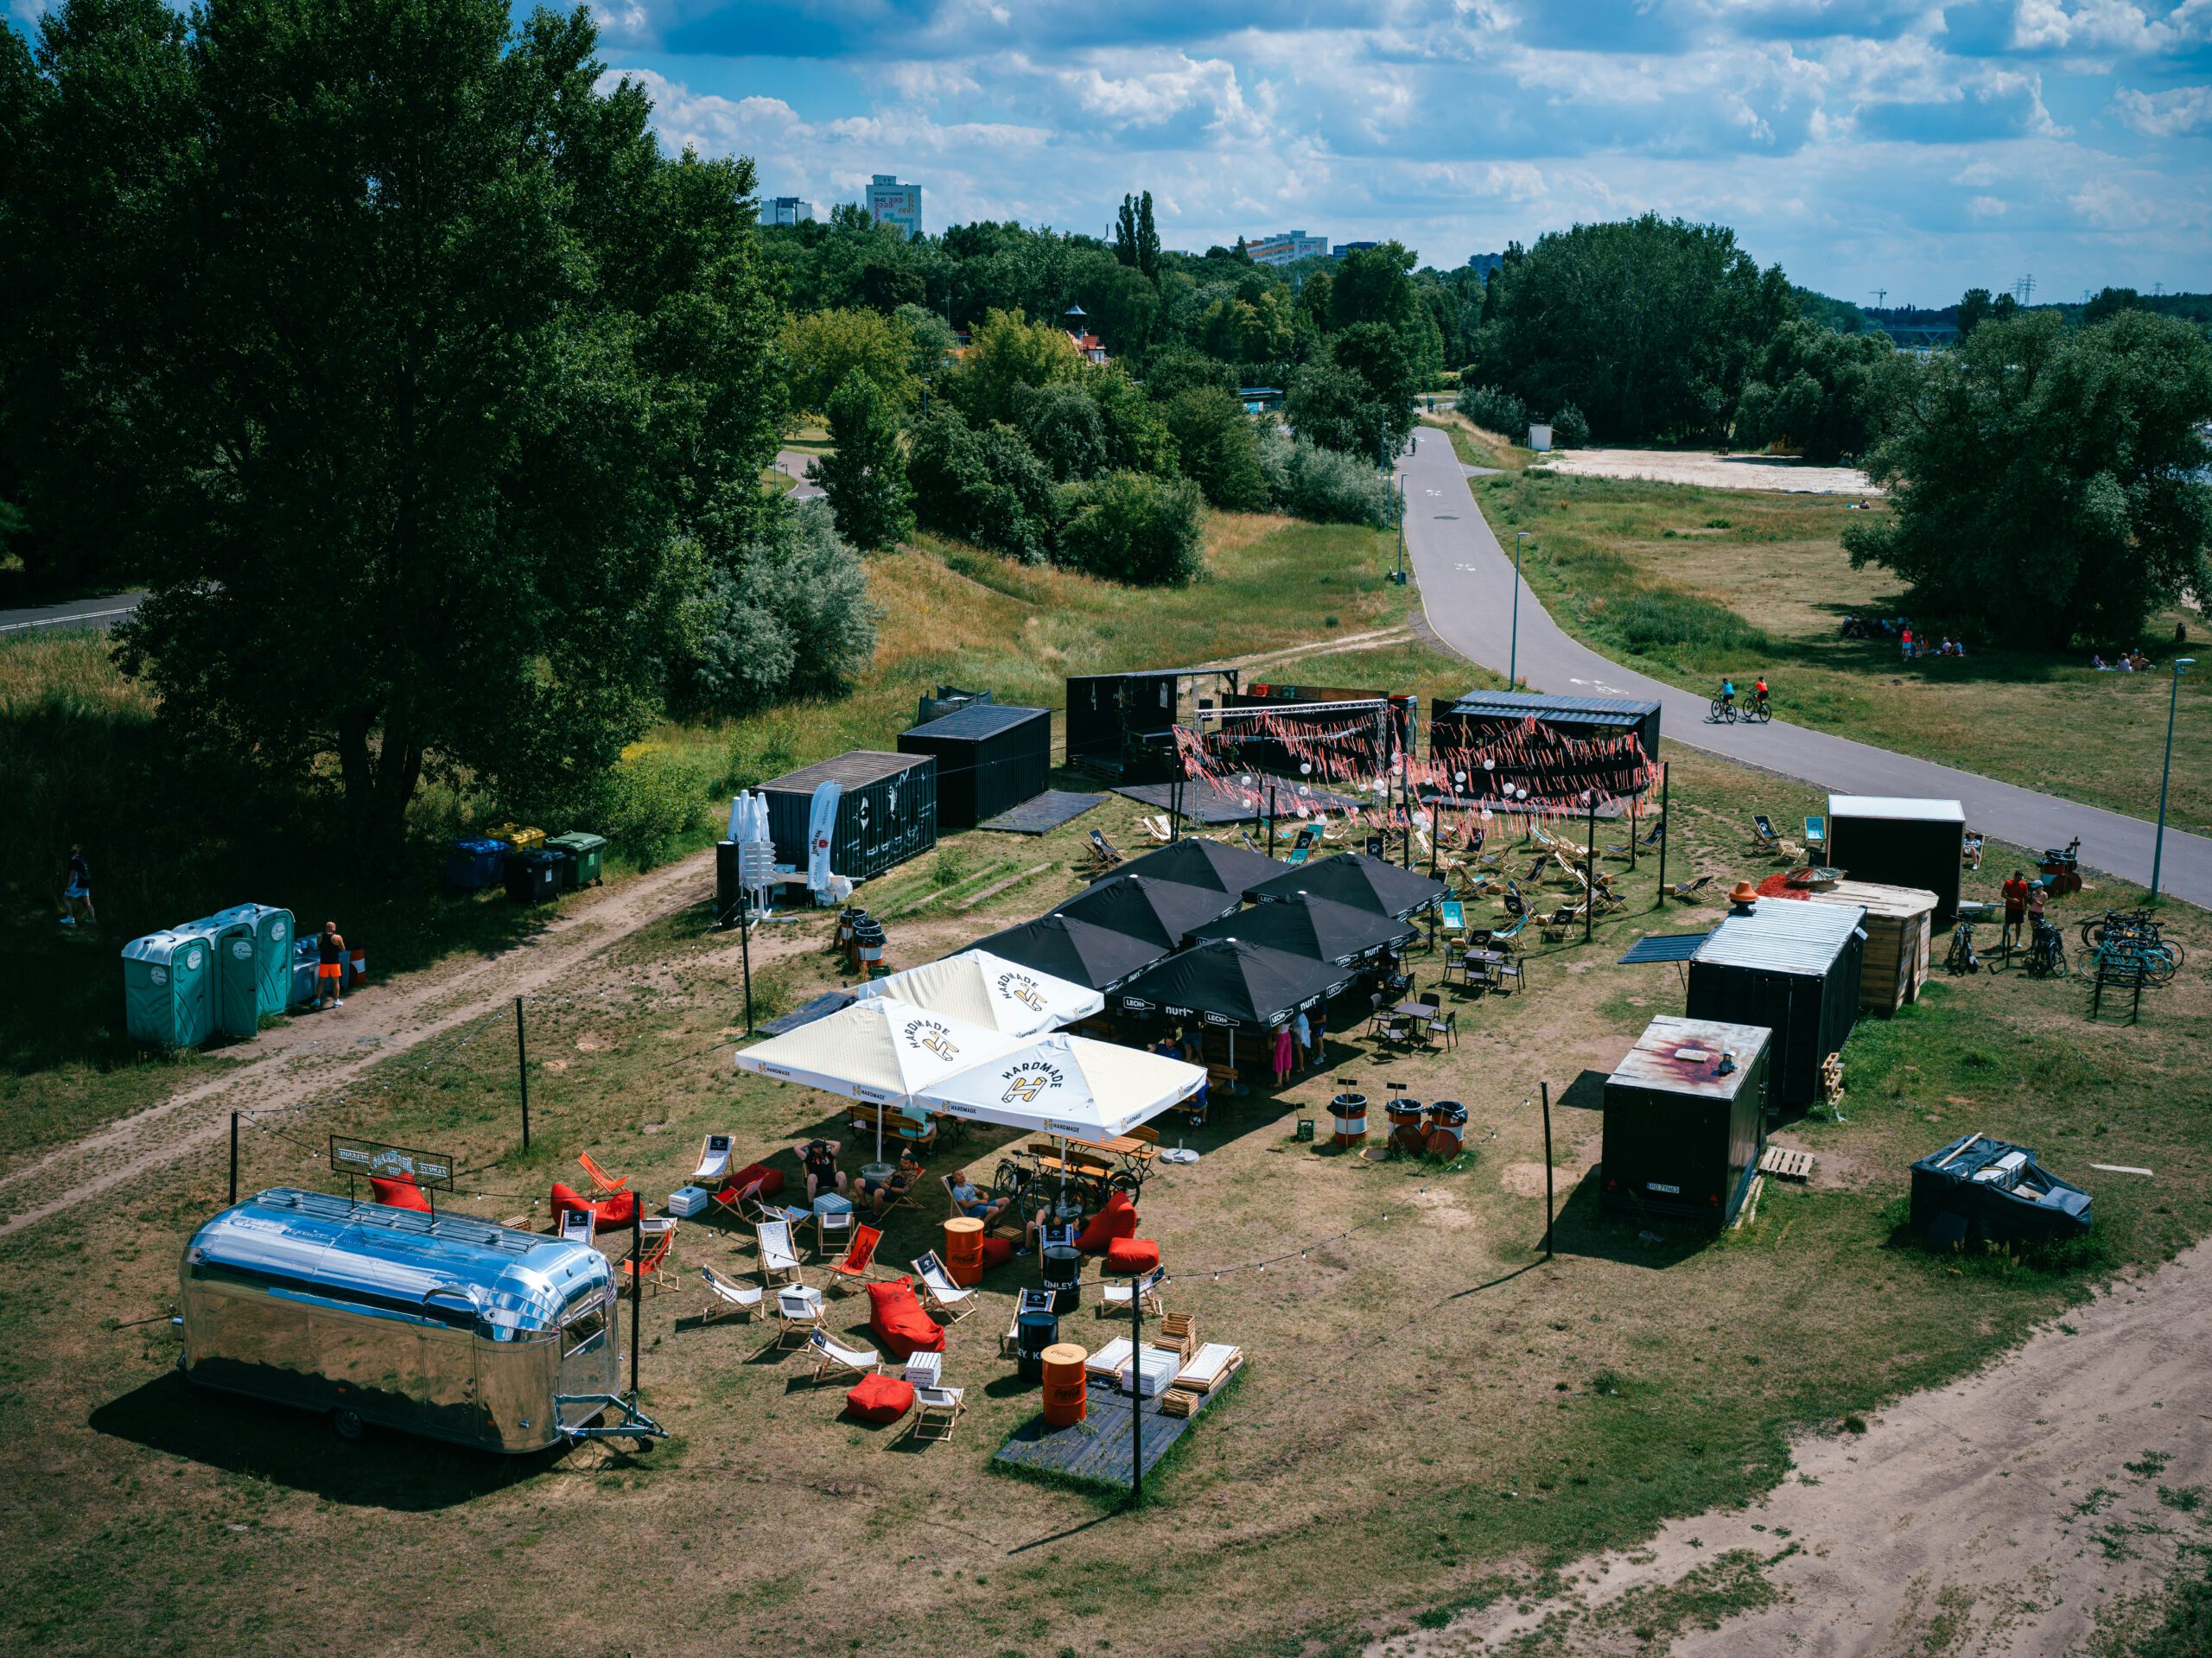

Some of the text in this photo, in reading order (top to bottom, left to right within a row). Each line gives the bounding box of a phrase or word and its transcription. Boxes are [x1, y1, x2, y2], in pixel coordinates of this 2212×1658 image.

[823, 800, 831, 825] WELCOME
[998, 972, 1039, 1000] HARDMADE
[1127, 999, 1141, 1007] LECH
[1208, 1013, 1224, 1023] LECH
[1272, 1014, 1283, 1023] LECH
[904, 1020, 950, 1049] HARDMADE
[766, 1066, 791, 1077] HARDMADE
[1001, 1062, 1064, 1088] HARDMADE
[861, 1089, 886, 1101] HARDMADE
[950, 1104, 976, 1115] HARDMADE
[1052, 1123, 1080, 1134] HARDMADE
[1044, 1279, 1073, 1290] KINLEY
